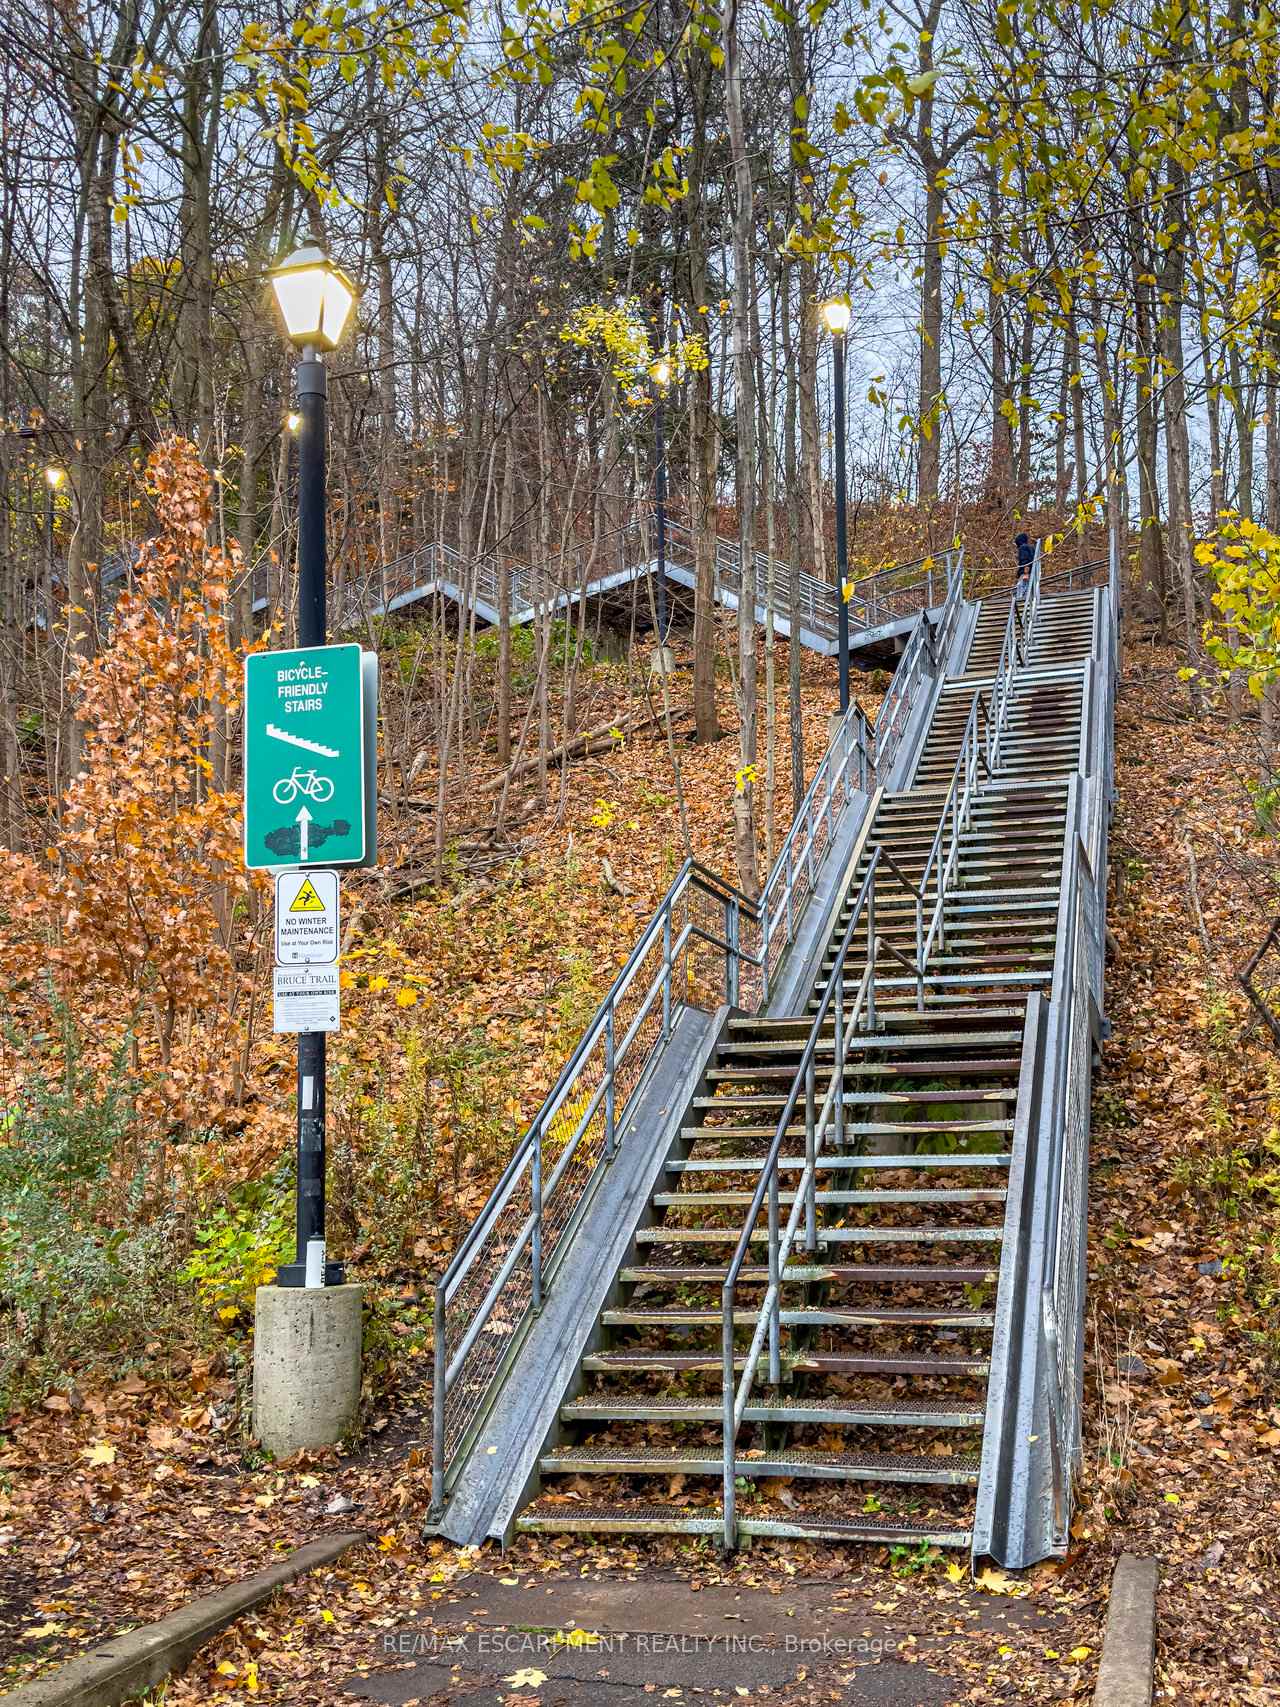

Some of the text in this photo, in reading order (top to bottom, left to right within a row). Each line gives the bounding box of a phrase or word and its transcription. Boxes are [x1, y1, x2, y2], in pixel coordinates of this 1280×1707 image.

[277, 666, 328, 682] BICYCLE-
[278, 682, 328, 698] FRIENDLY
[285, 698, 322, 713] STAIRS
[299, 917, 327, 925] WINTER
[281, 926, 334, 935] MAINTENANCE
[277, 974, 336, 985] BRUCE TRAIL
